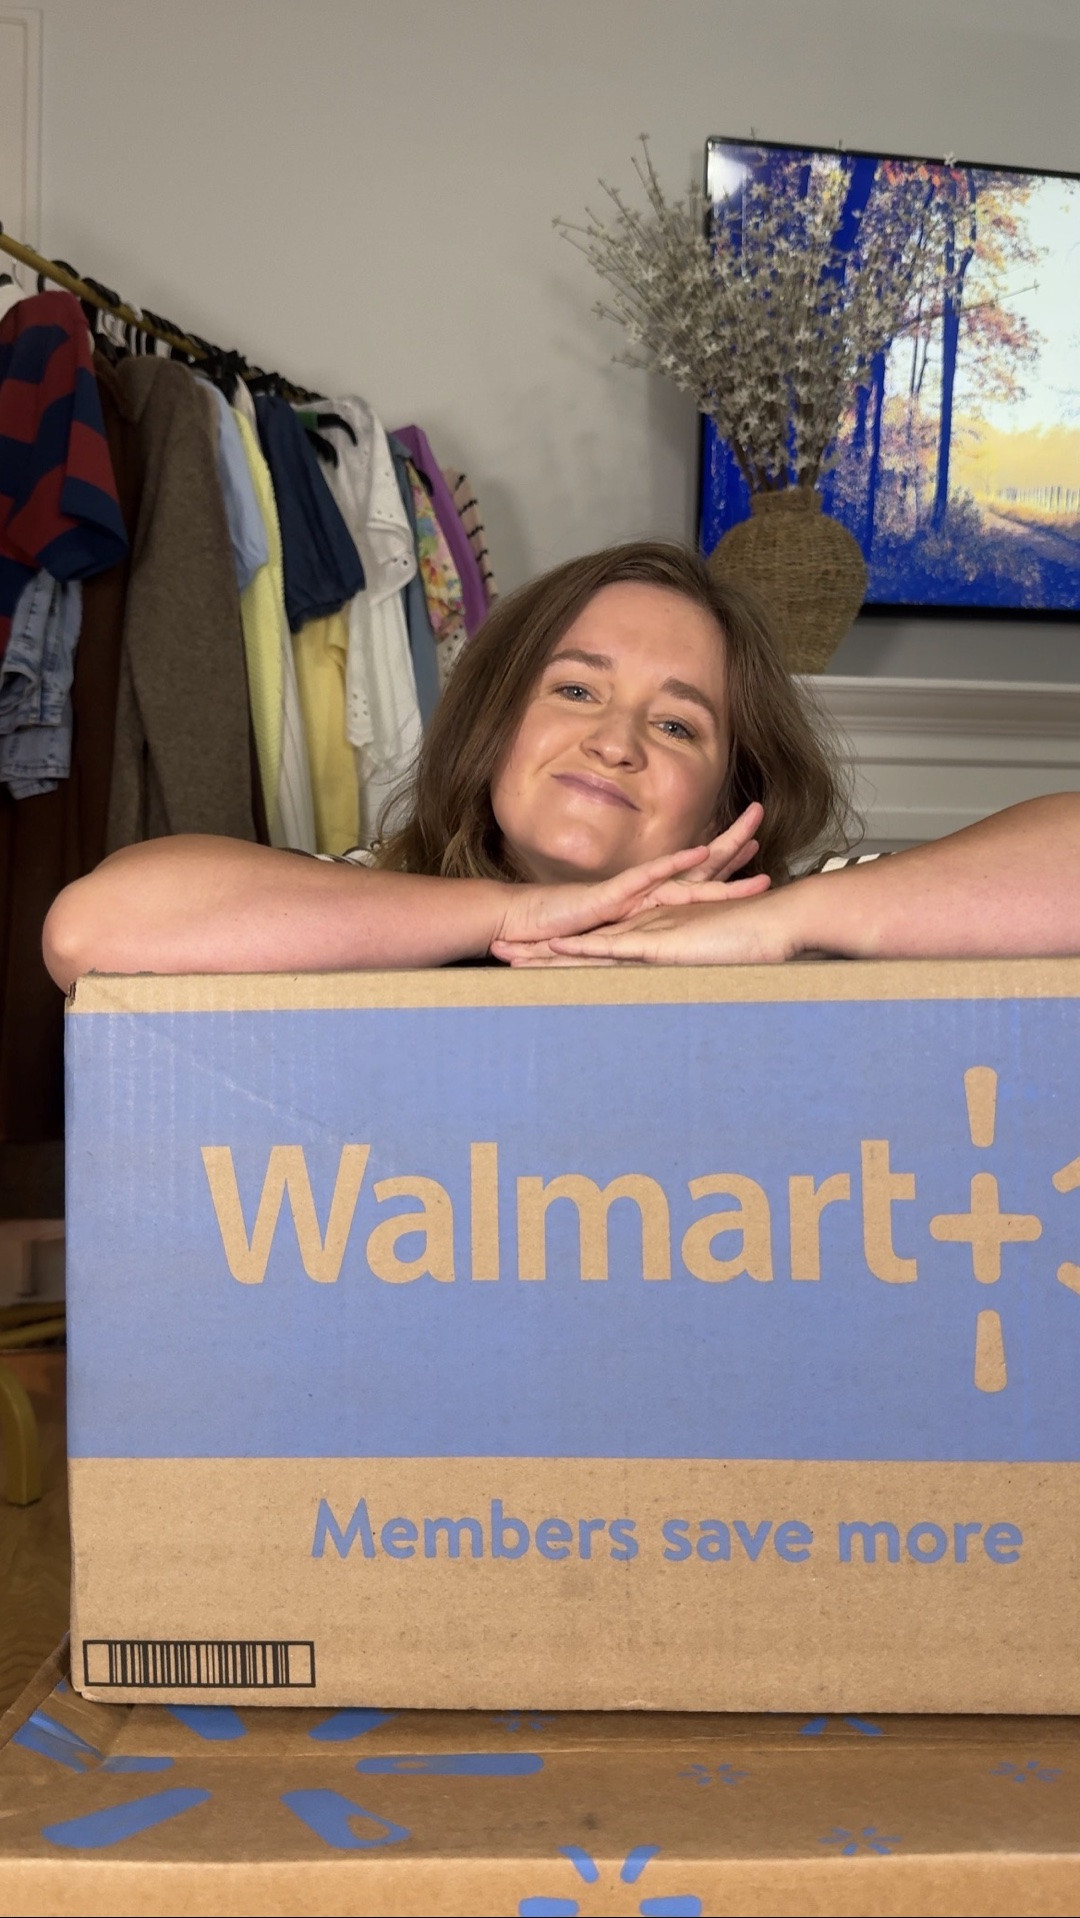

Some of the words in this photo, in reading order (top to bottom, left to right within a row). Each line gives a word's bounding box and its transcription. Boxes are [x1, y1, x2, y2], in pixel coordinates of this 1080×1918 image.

[311, 1497, 640, 1561] Members
[661, 1519, 814, 1563] save
[838, 1521, 1024, 1565] more
